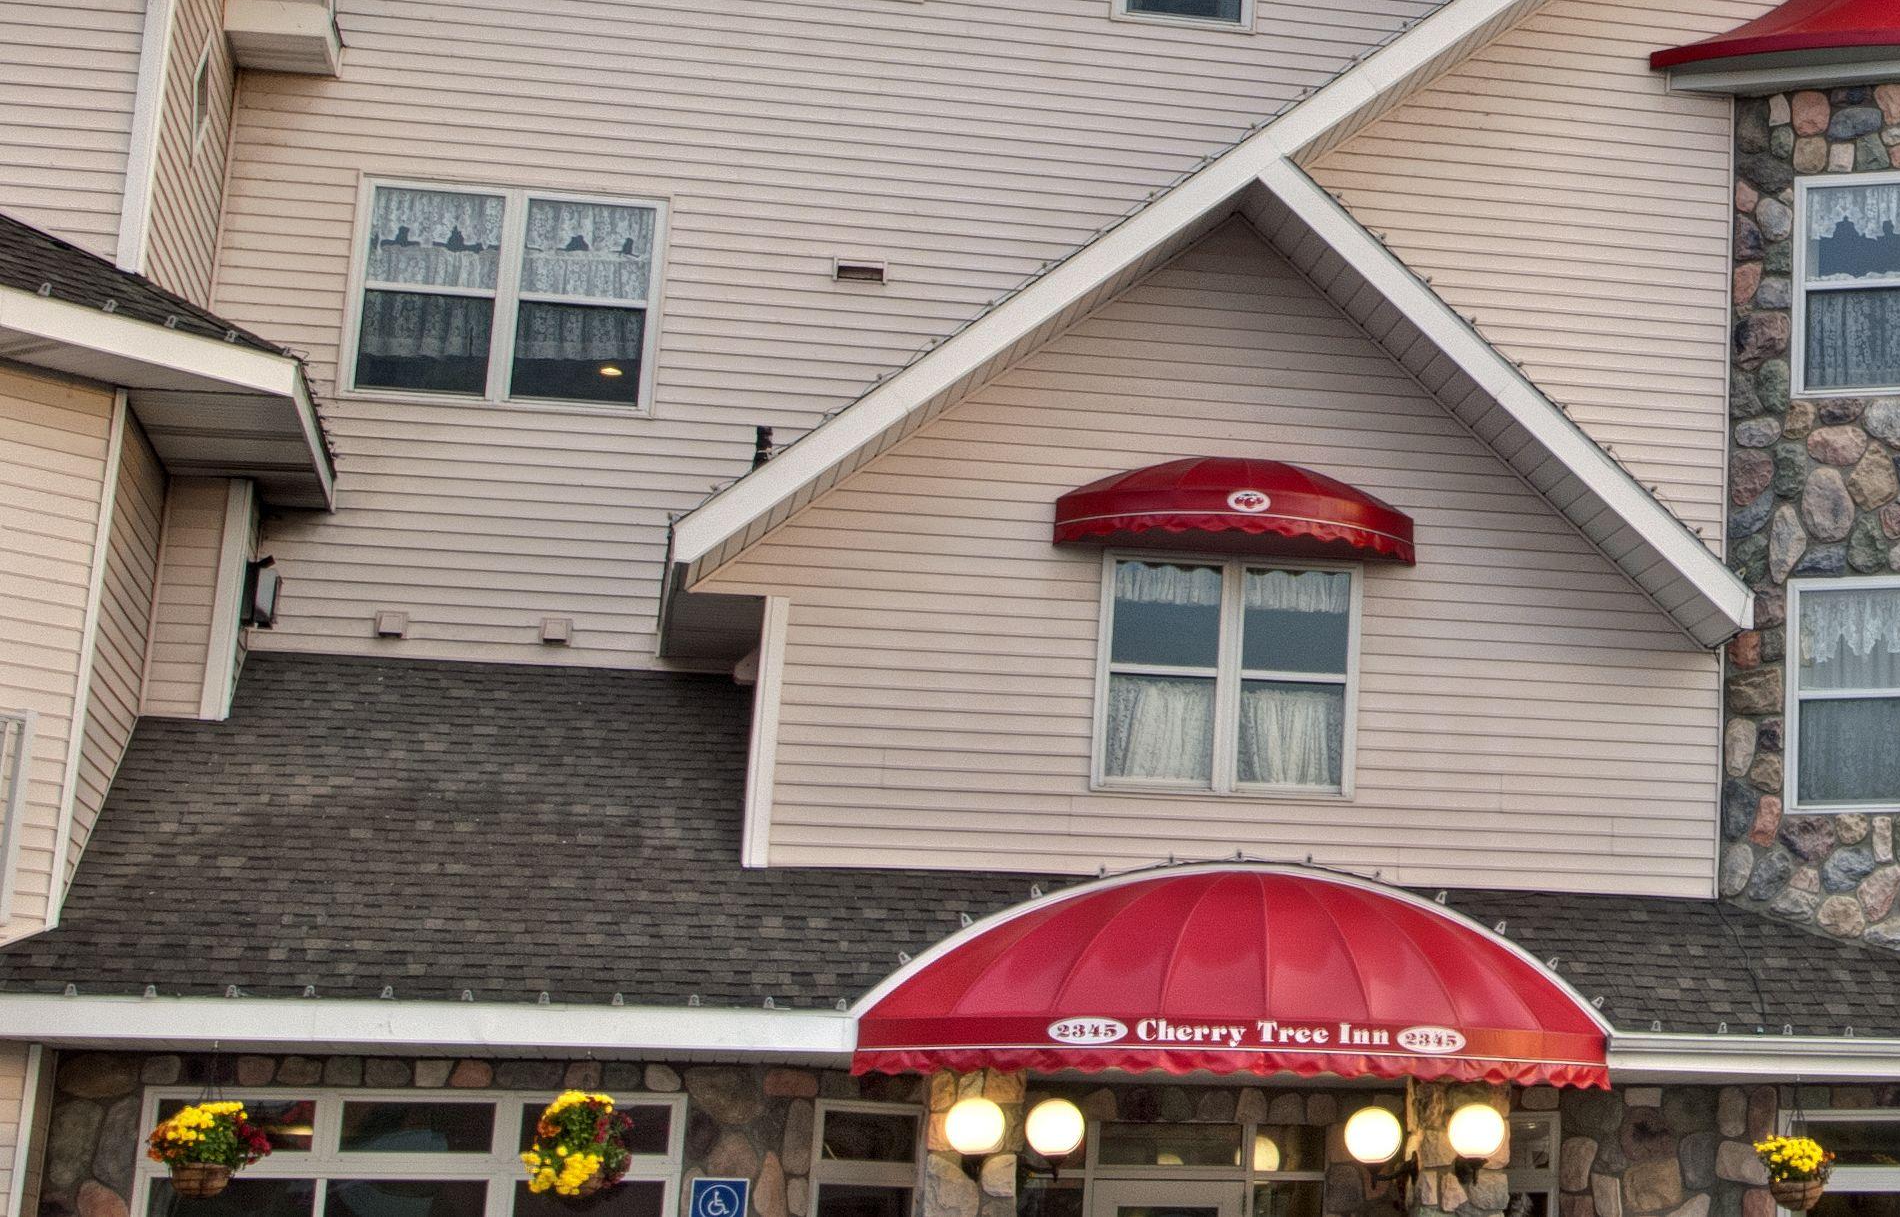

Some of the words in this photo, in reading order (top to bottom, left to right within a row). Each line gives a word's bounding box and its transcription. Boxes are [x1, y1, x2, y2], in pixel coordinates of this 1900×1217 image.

[1056, 1022, 1119, 1039] 2345
[1135, 1019, 1247, 1048] Cherry
[1257, 1020, 1330, 1044] Tree
[1339, 1022, 1391, 1046] Inn
[1404, 1030, 1458, 1048] 2345
